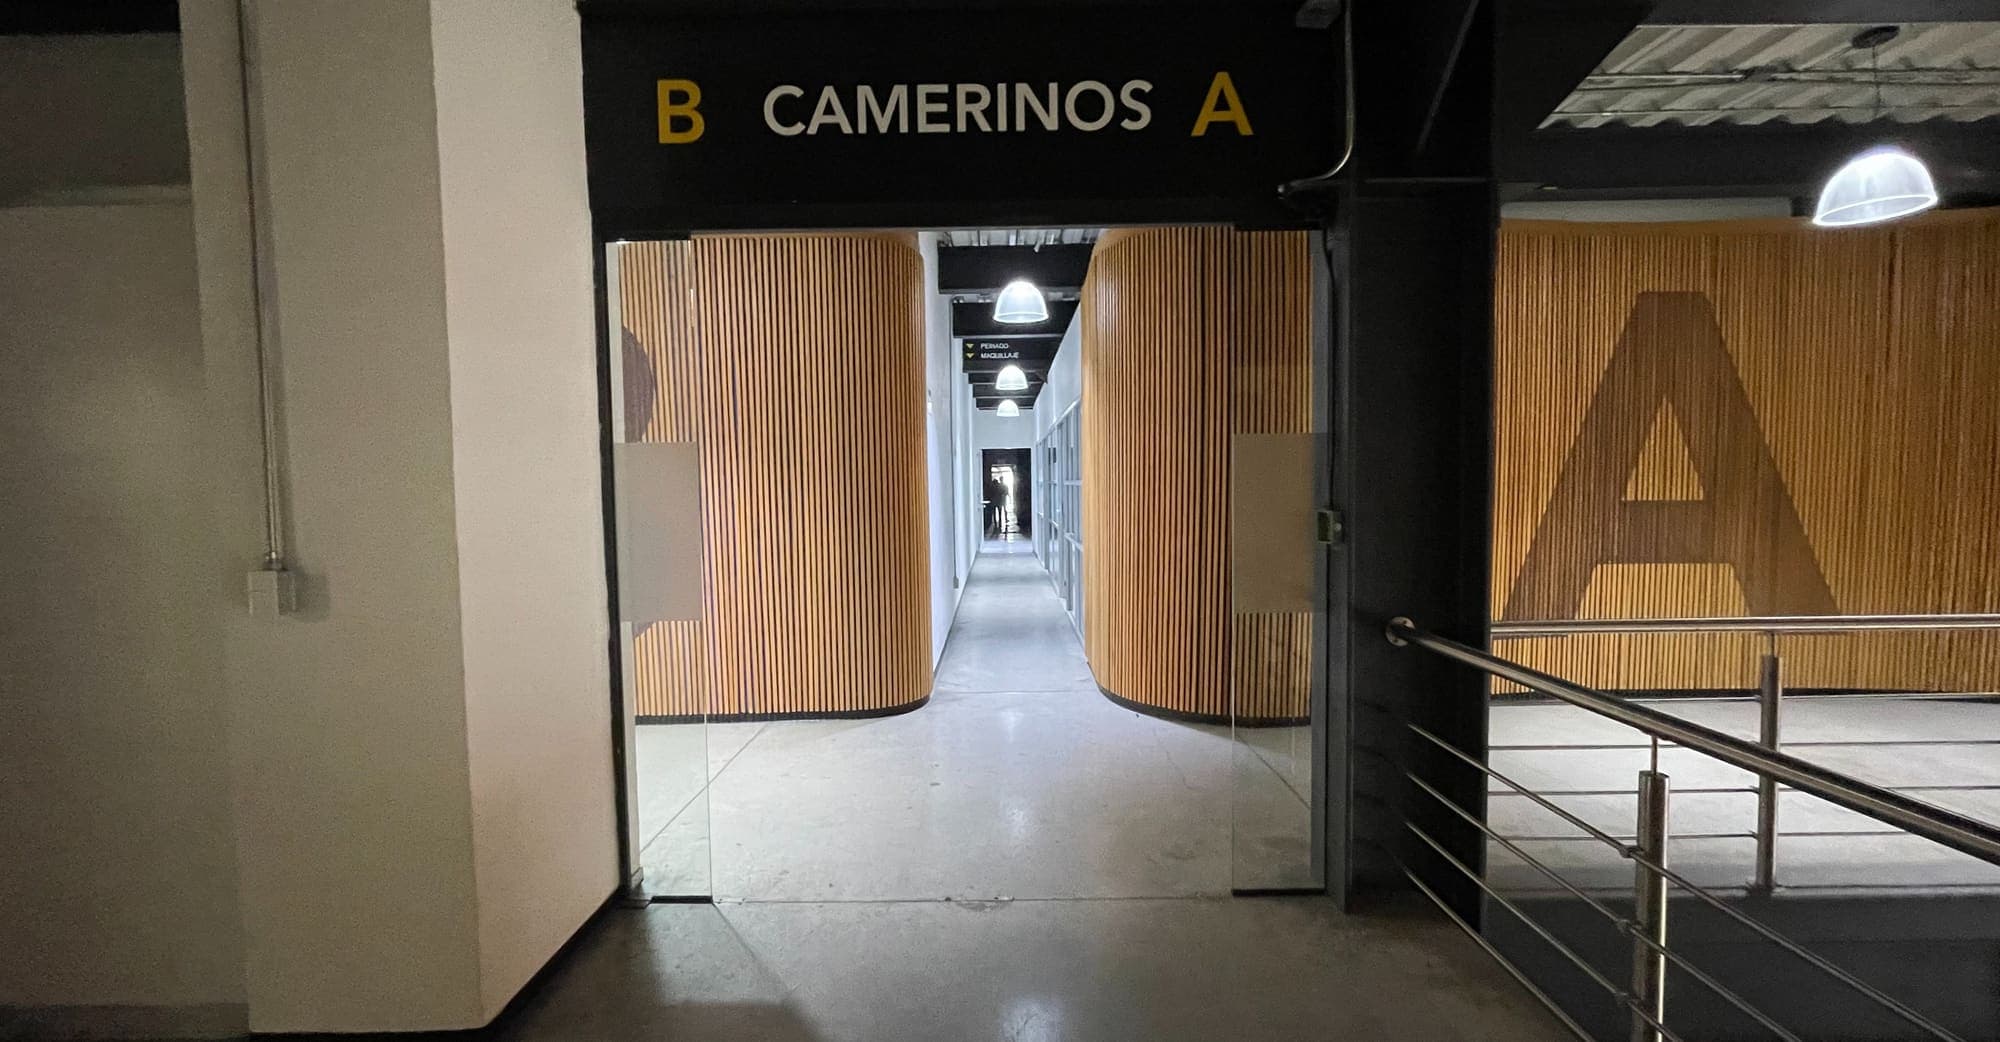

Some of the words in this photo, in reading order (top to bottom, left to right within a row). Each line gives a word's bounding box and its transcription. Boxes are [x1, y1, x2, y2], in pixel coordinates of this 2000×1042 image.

[657, 79, 705, 144] B
[763, 80, 1153, 137] CAMERINOS
[1192, 72, 1252, 136] A
[1503, 290, 1842, 620] A
